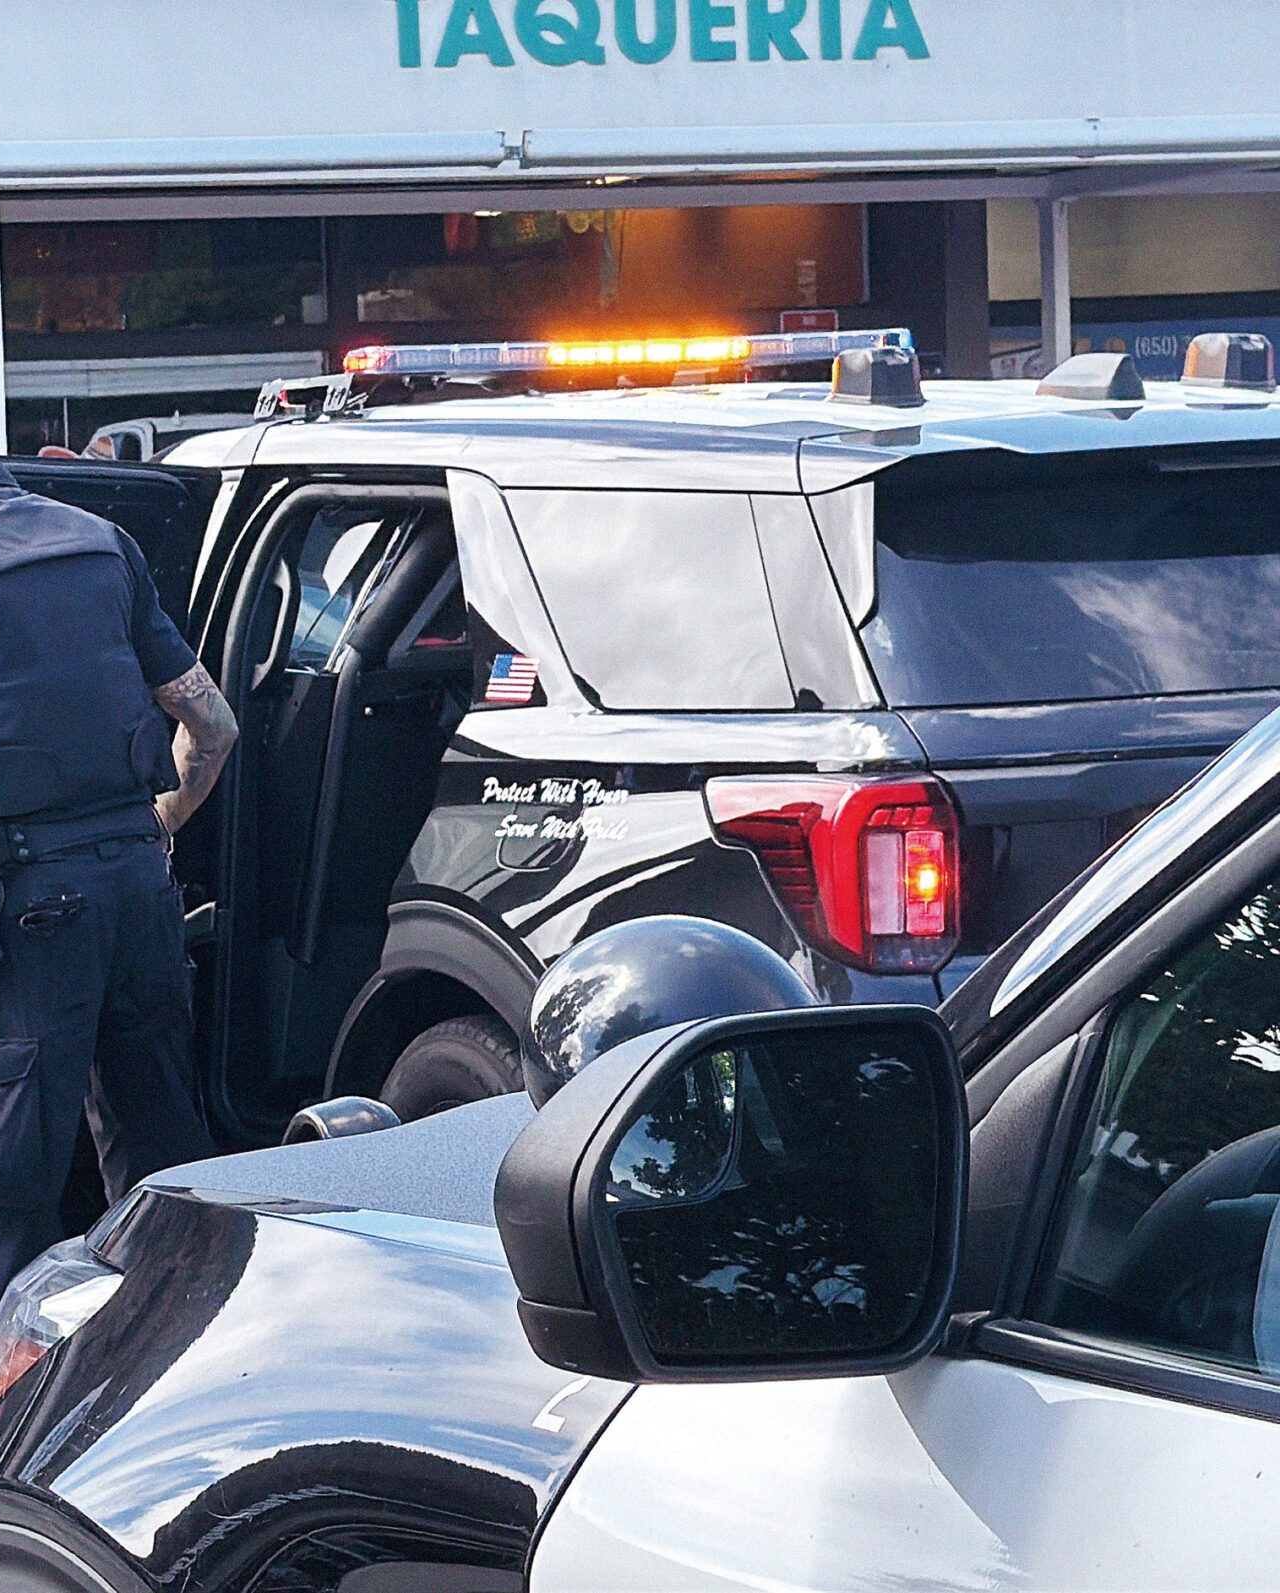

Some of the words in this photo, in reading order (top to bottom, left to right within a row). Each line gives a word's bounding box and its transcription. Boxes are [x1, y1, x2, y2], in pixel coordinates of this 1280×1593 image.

[394, 0, 931, 68] TAQUERIA
[1135, 336, 1177, 358] (650)
[482, 777, 537, 803] Protect
[540, 778, 578, 803] With
[582, 778, 629, 803] Honor
[540, 815, 582, 839] With
